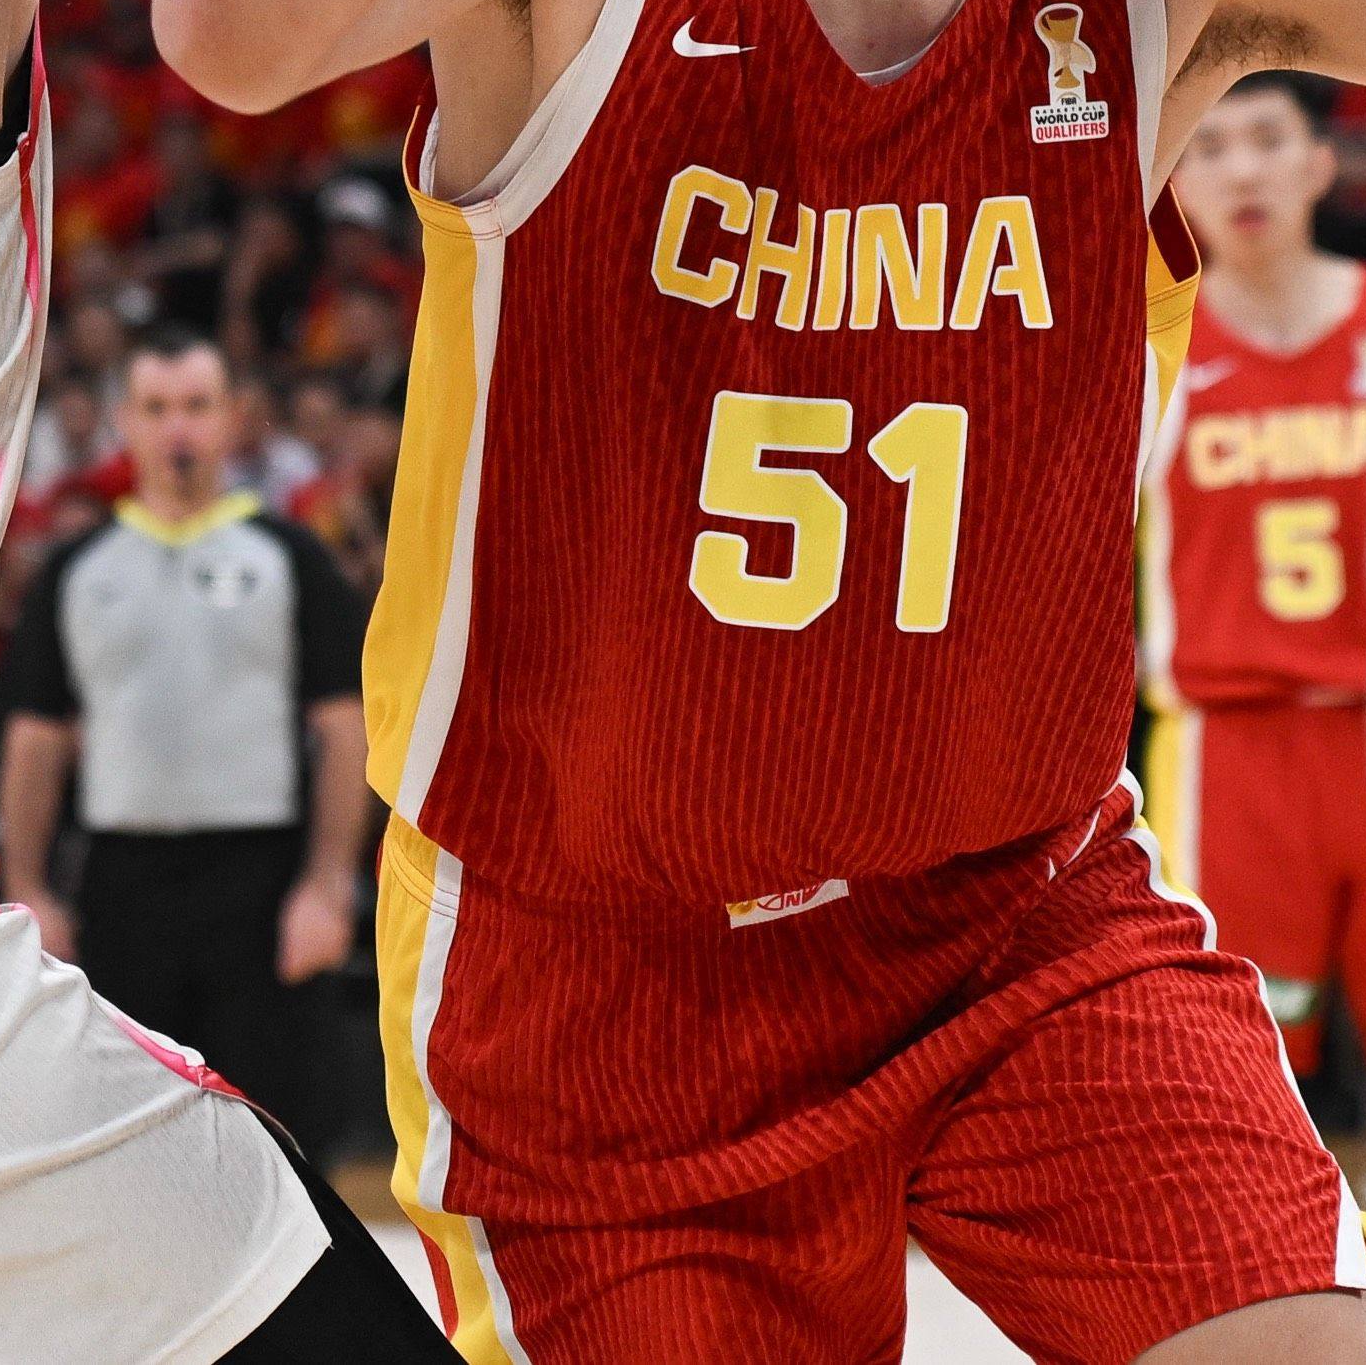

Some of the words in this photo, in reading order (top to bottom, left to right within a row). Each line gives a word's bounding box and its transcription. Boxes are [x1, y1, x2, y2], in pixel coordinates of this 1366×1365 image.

[1035, 105, 1104, 115] BASKETBALL
[1035, 112, 1079, 125] WORLD
[1081, 110, 1106, 123] CUP
[1036, 123, 1106, 141] QUALIFIERS
[651, 164, 1055, 332] CHINA
[688, 390, 968, 633] 51
[1255, 498, 1346, 621] 5
